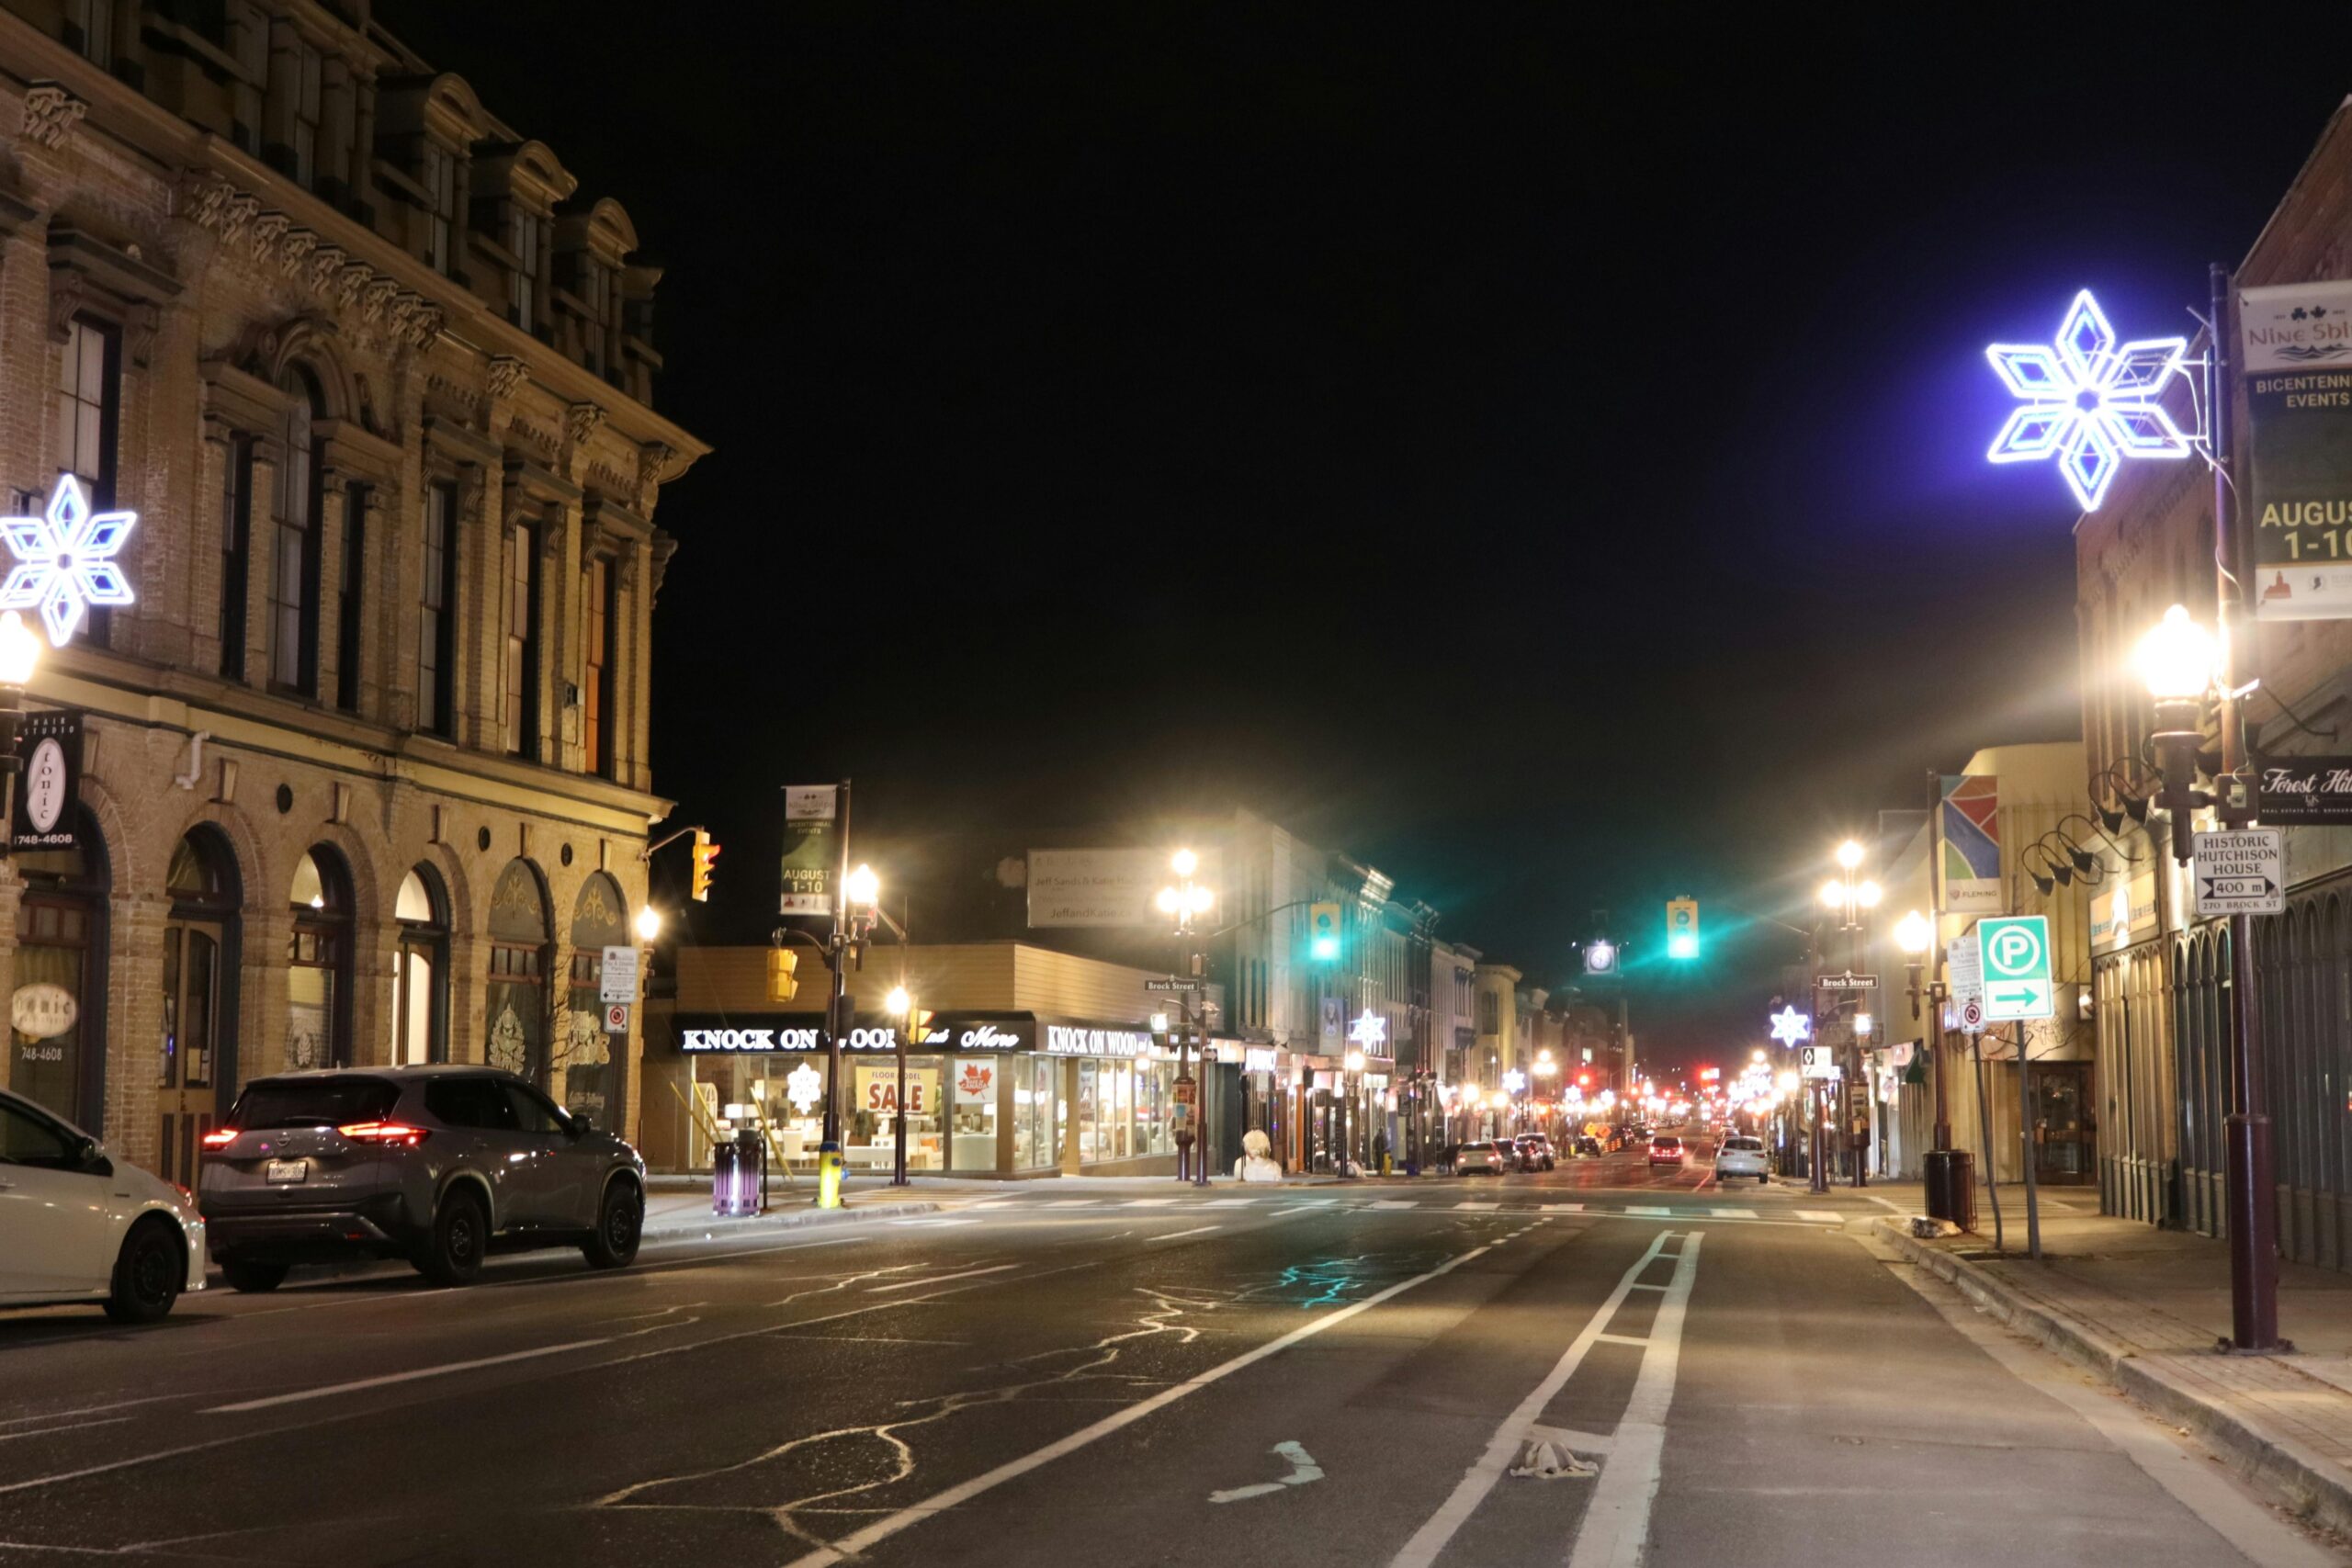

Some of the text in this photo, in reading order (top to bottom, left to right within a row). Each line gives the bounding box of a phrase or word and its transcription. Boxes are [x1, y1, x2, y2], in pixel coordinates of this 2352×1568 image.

[2312, 320, 2352, 341] Shi
[2286, 392, 2350, 408] EVENTS
[2260, 501, 2352, 528] AUGU
[33, 717, 65, 727] HAIR
[24, 726, 74, 736] STUDIO
[40, 752, 52, 819] tonic
[2260, 768, 2319, 794] Forest
[17, 834, 73, 845] 748-4608
[2204, 836, 2270, 849] HISTORIC
[2198, 849, 2278, 863] HUTCHISON
[784, 869, 831, 880] AUGUST
[2212, 863, 2263, 875] HOUSE
[1035, 875, 1053, 886] Jeff
[792, 881, 823, 893] 1-10
[2216, 882, 2262, 894] 400 m
[2202, 899, 2278, 910] 270 BROCK ST
[2001, 935, 2029, 966] P
[1148, 981, 1195, 990] Brock Street
[1823, 978, 1873, 987] Brock Street
[683, 1029, 775, 1049] KNOCK
[780, 1029, 819, 1049] ON
[960, 1025, 1020, 1048] More
[1047, 1025, 1088, 1055] KNOCK
[1089, 1030, 1105, 1055] ON
[1106, 1032, 1137, 1055] WOOD
[21, 1046, 62, 1061] 748-4608
[872, 1071, 895, 1080] FLOOR
